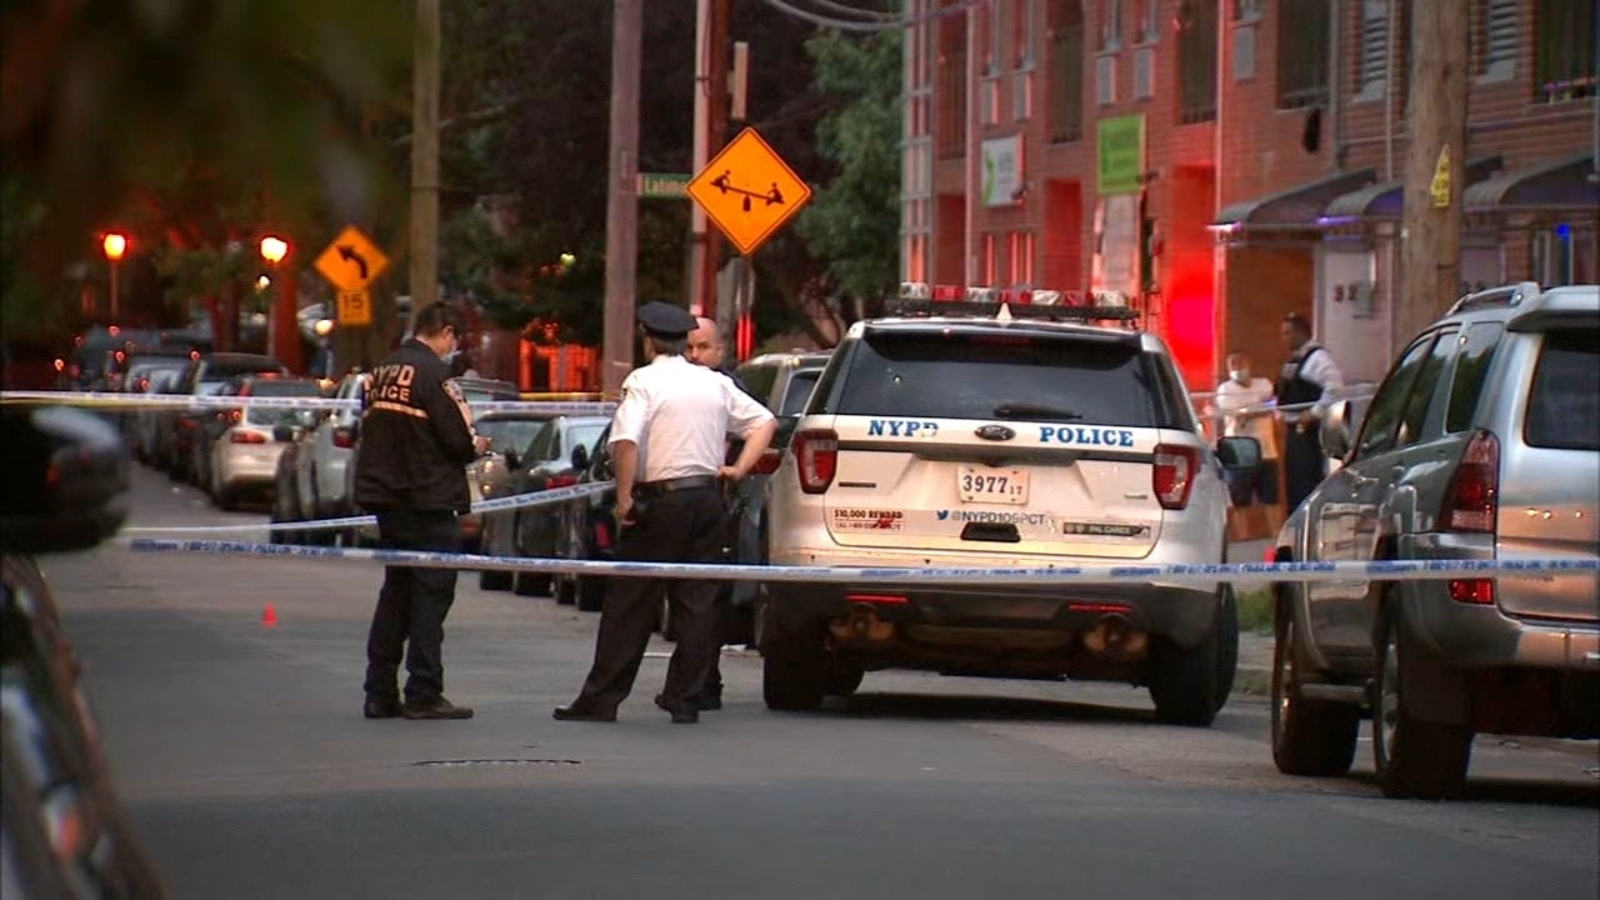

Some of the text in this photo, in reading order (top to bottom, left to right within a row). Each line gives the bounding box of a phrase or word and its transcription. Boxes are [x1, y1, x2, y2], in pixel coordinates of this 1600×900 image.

[343, 293, 363, 310] 15
[1039, 426, 1134, 447] POLICE
[963, 474, 1008, 493] 3977
[868, 510, 903, 519] REWARD
